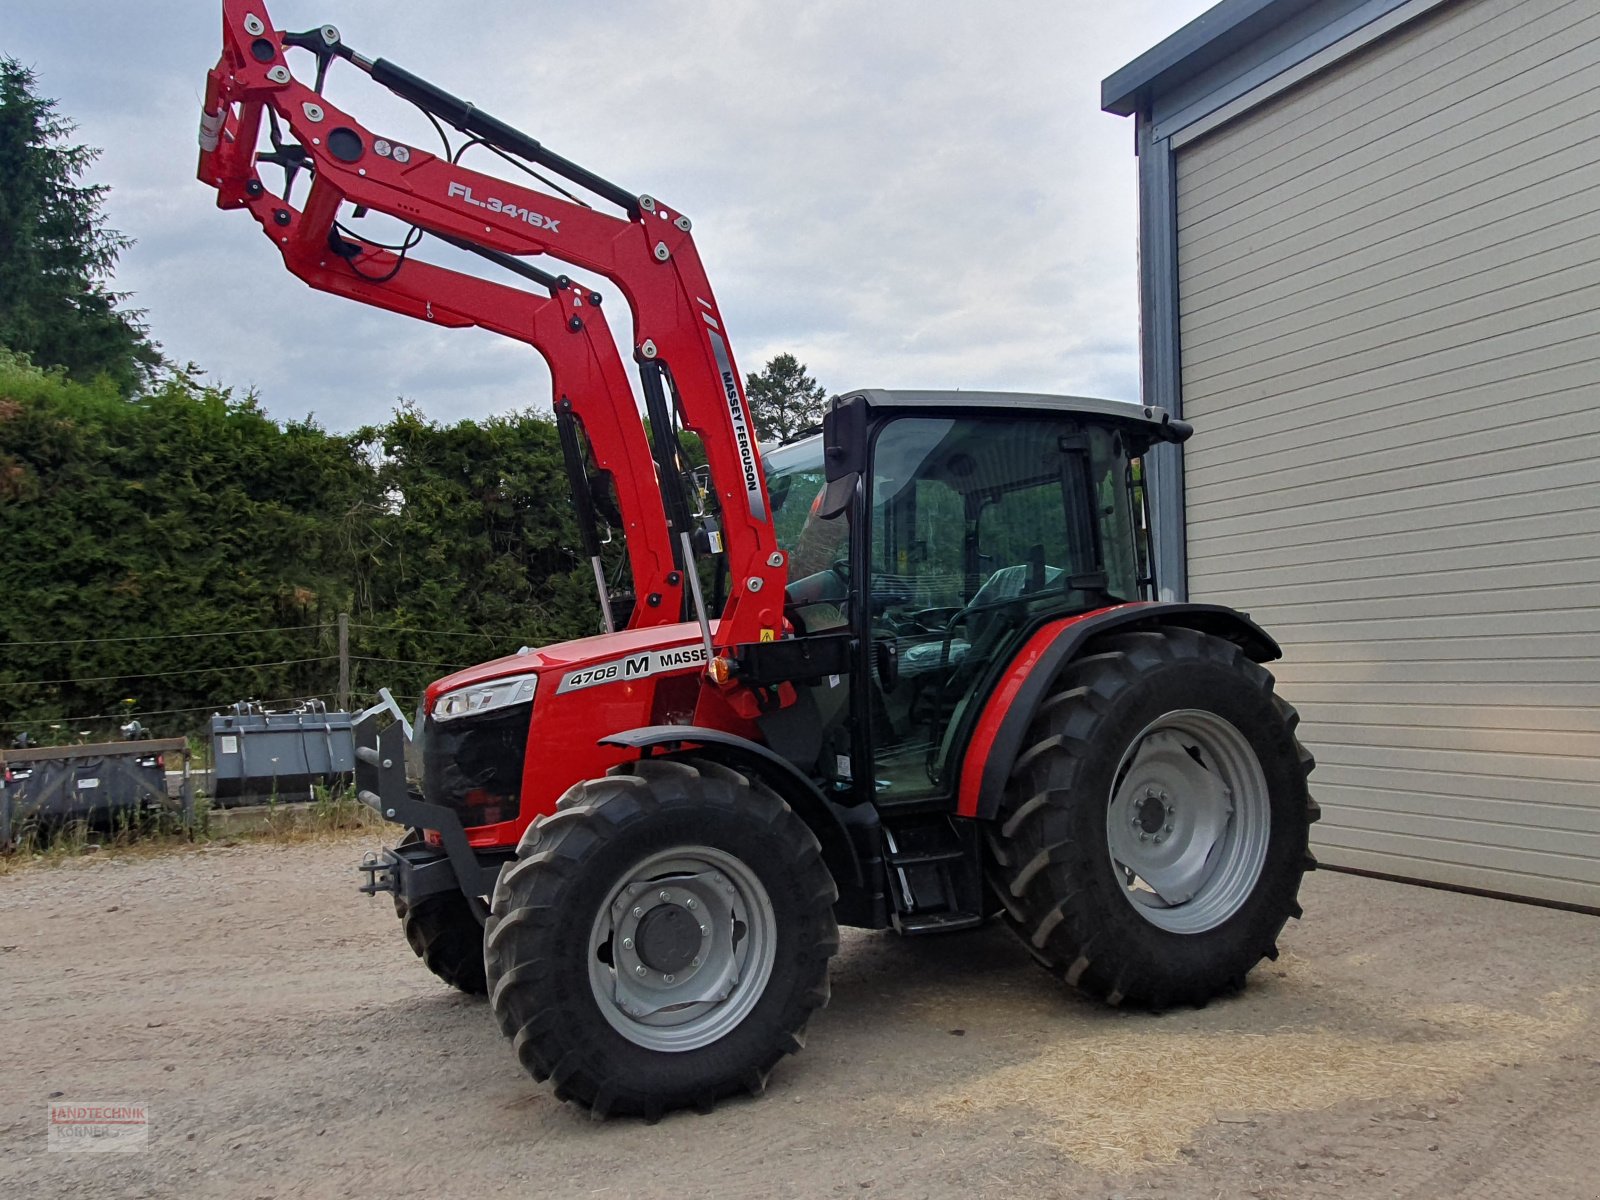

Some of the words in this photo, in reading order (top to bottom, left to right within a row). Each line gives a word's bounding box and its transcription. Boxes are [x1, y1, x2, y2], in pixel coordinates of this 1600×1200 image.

[448, 181, 560, 233] FL.3416X
[721, 371, 743, 422] MASSEY
[736, 425, 757, 491] FERGUSON
[569, 666, 618, 686] 4708
[625, 656, 649, 676] M
